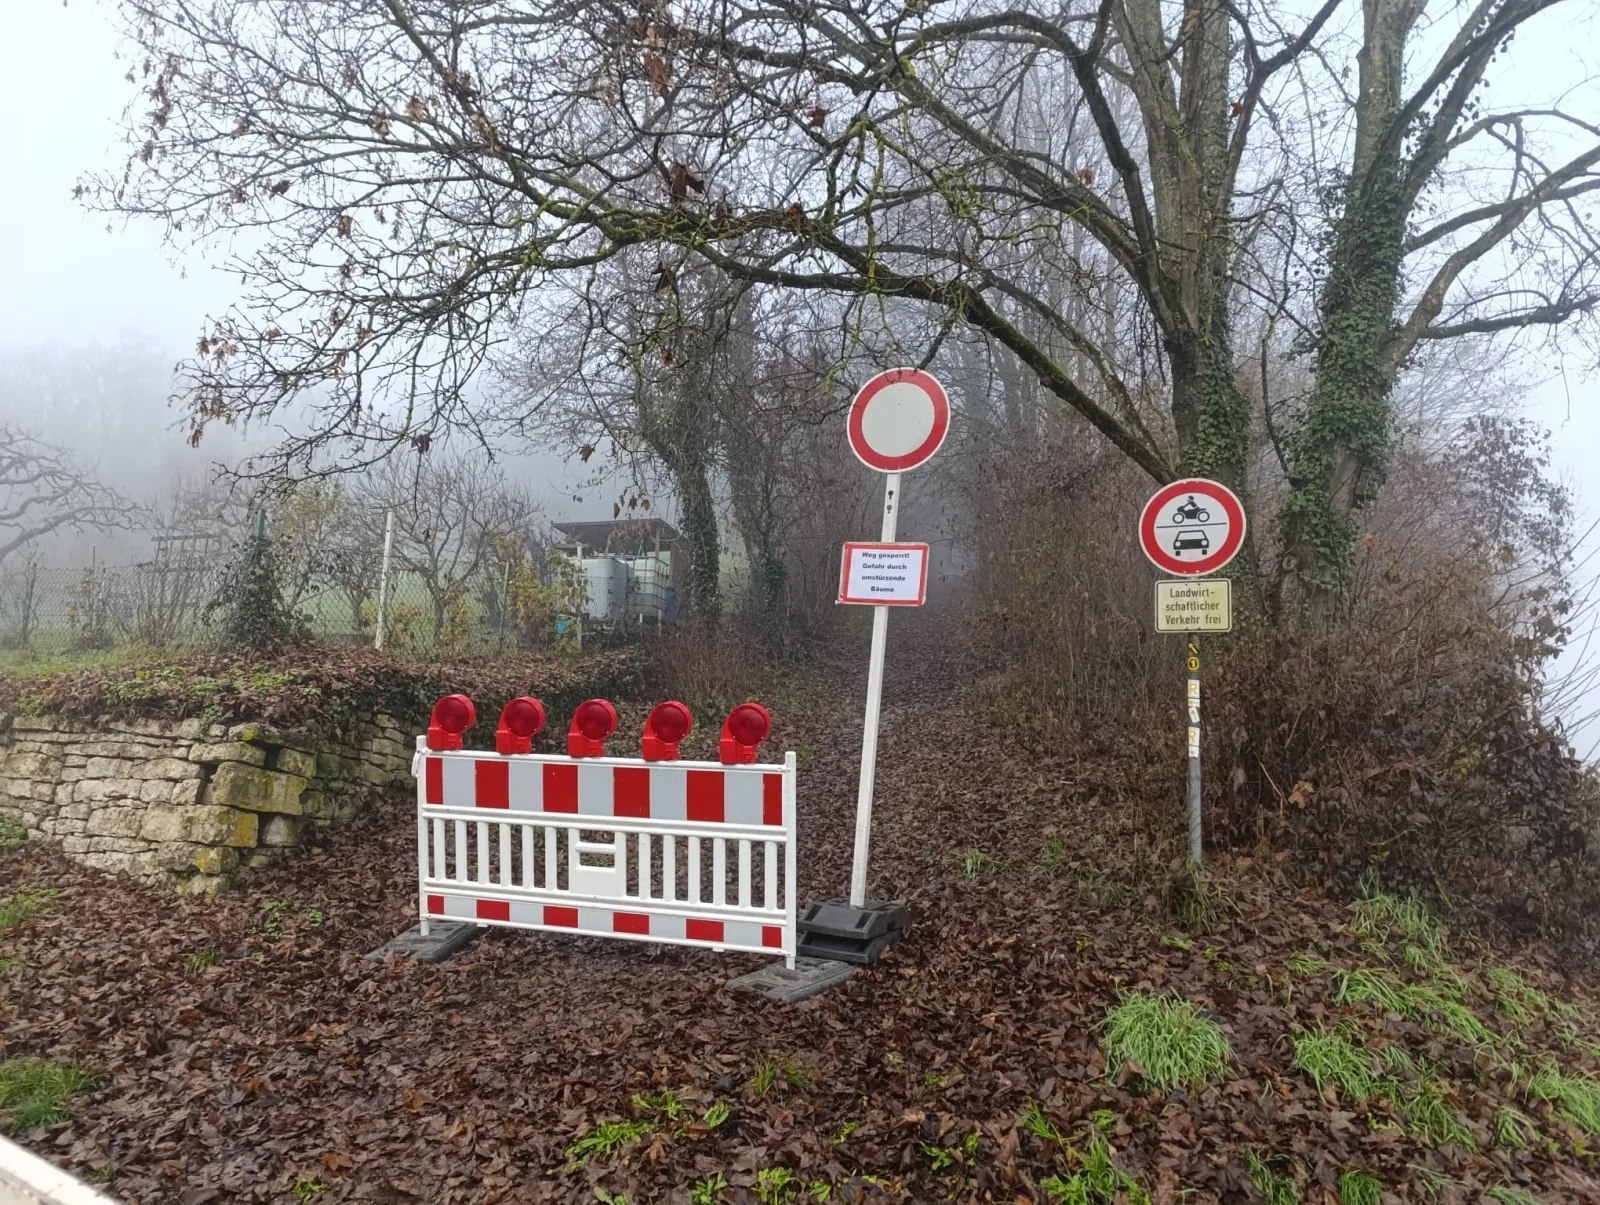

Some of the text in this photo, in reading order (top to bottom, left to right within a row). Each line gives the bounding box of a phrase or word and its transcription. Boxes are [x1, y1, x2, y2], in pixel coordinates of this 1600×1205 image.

[1170, 588, 1215, 598] Landwirt-
[1165, 601, 1220, 611] schaftlicher
[1165, 614, 1221, 625] Verkehr frei
[1189, 683, 1198, 695] R
[1189, 730, 1197, 743] R
